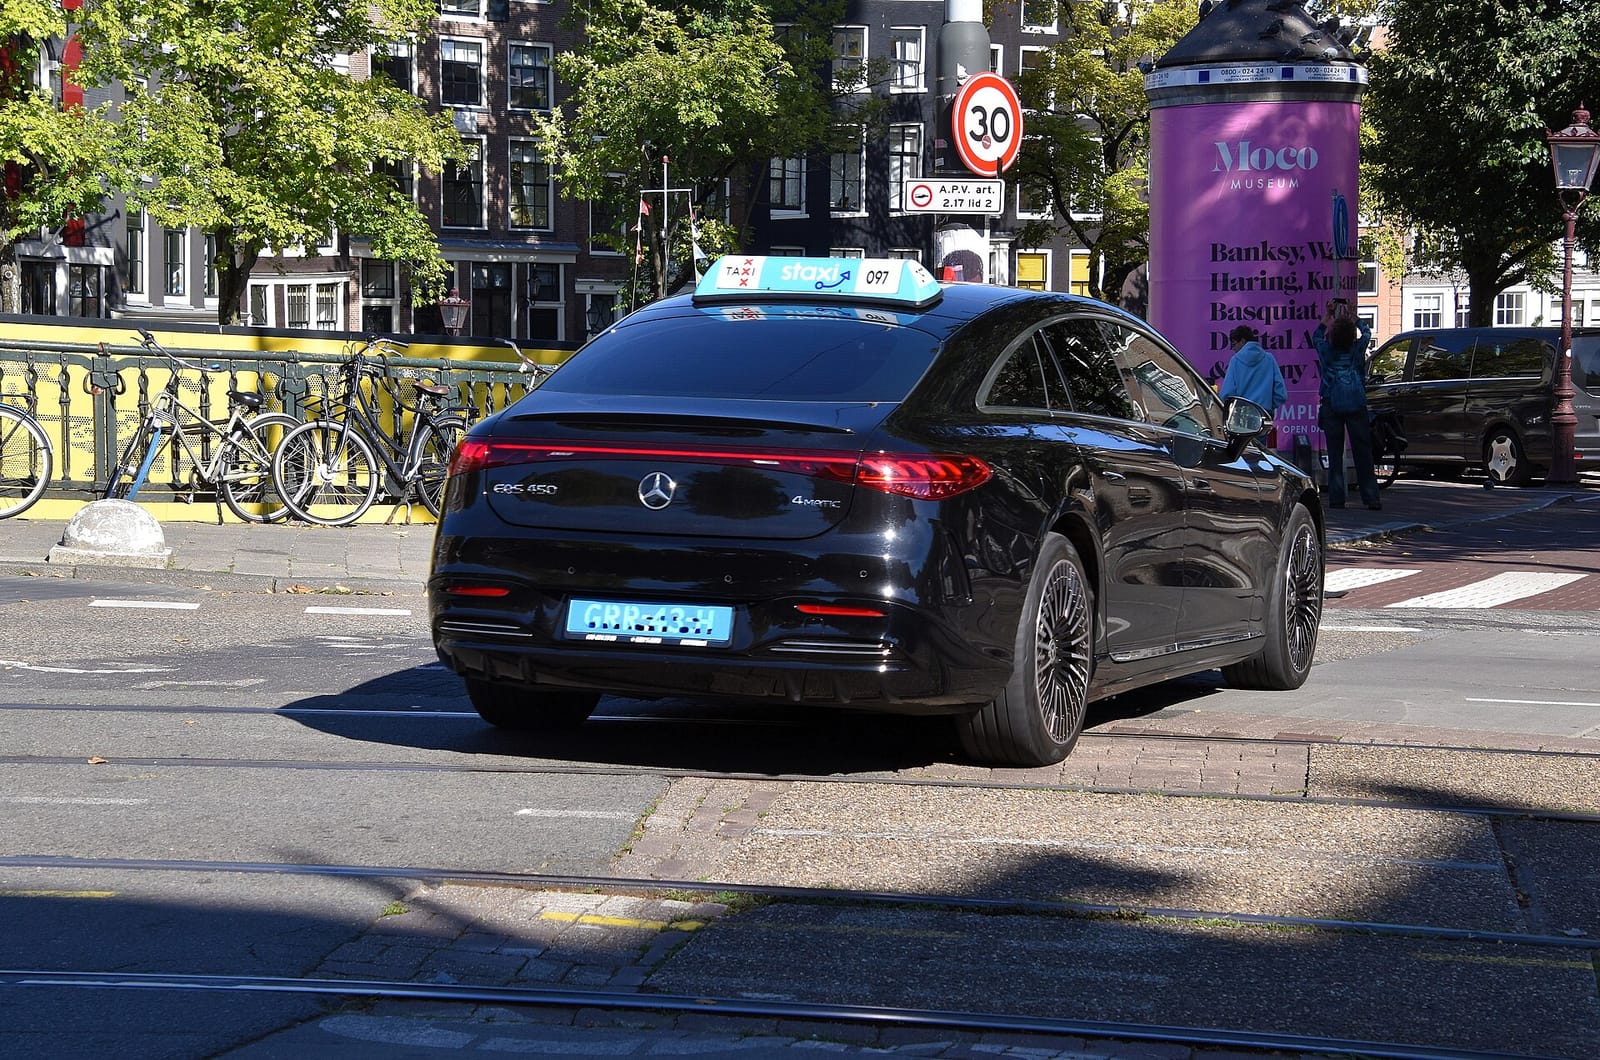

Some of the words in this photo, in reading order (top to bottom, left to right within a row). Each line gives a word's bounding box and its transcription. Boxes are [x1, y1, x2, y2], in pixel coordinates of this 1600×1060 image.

[969, 105, 1010, 143] 30
[1211, 141, 1319, 172] Moco
[940, 185, 970, 194] A.P.V.
[976, 186, 995, 194] art.
[1230, 178, 1298, 190] MUSEUM
[943, 199, 964, 208] 2.17
[968, 200, 980, 208] lid
[986, 200, 992, 208] 2
[1210, 240, 1305, 266] Banksy,
[781, 262, 840, 282] staxi
[866, 270, 889, 285] 097
[1210, 270, 1304, 296] Haring,
[1282, 426, 1308, 434] OPEN
[527, 484, 558, 494] 450
[792, 496, 841, 508] 4MATIC
